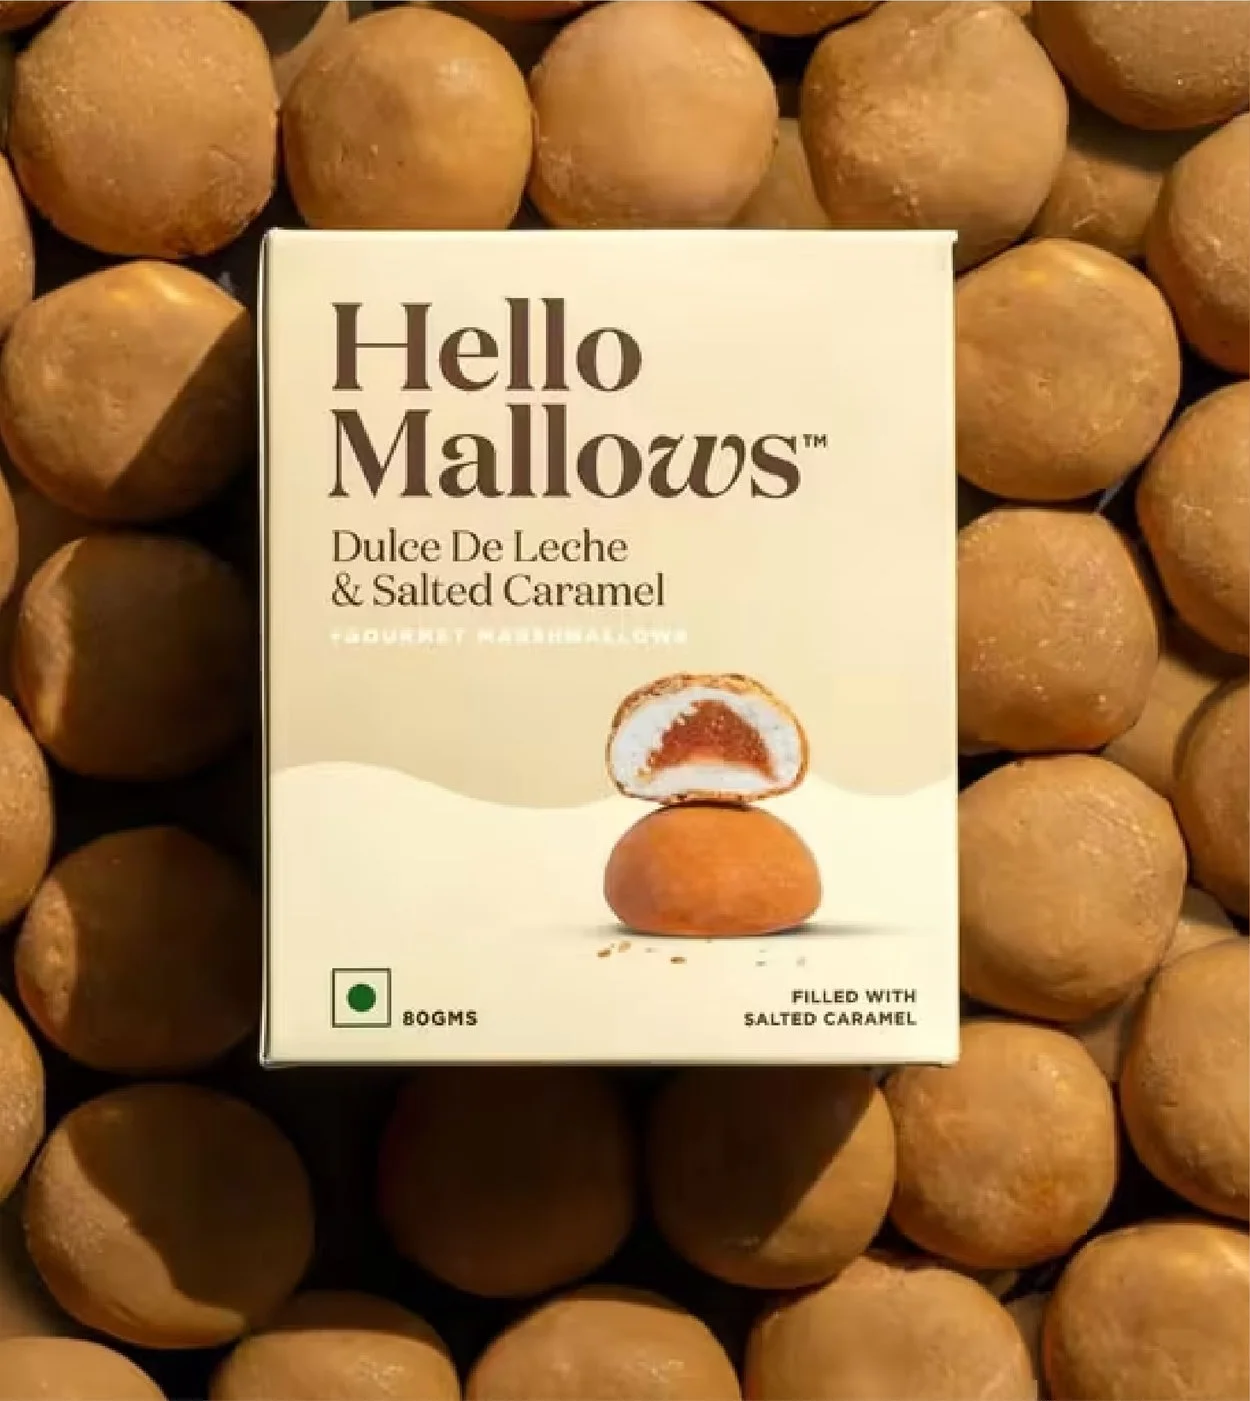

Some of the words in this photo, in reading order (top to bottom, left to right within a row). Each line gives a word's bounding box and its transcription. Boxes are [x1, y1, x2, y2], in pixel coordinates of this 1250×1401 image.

[331, 297, 643, 391] Hello
[332, 527, 441, 562] Dulce
[452, 529, 503, 562] De
[513, 527, 628, 562] Leche
[331, 571, 364, 607] &
[372, 571, 493, 607] Salted
[504, 571, 665, 607] Caramel
[791, 989, 859, 1003] FILLED
[865, 989, 918, 1003] WITH
[402, 1010, 478, 1027] 80GMS
[744, 1011, 818, 1026] SALTED
[823, 1011, 918, 1026] CARAMEL
